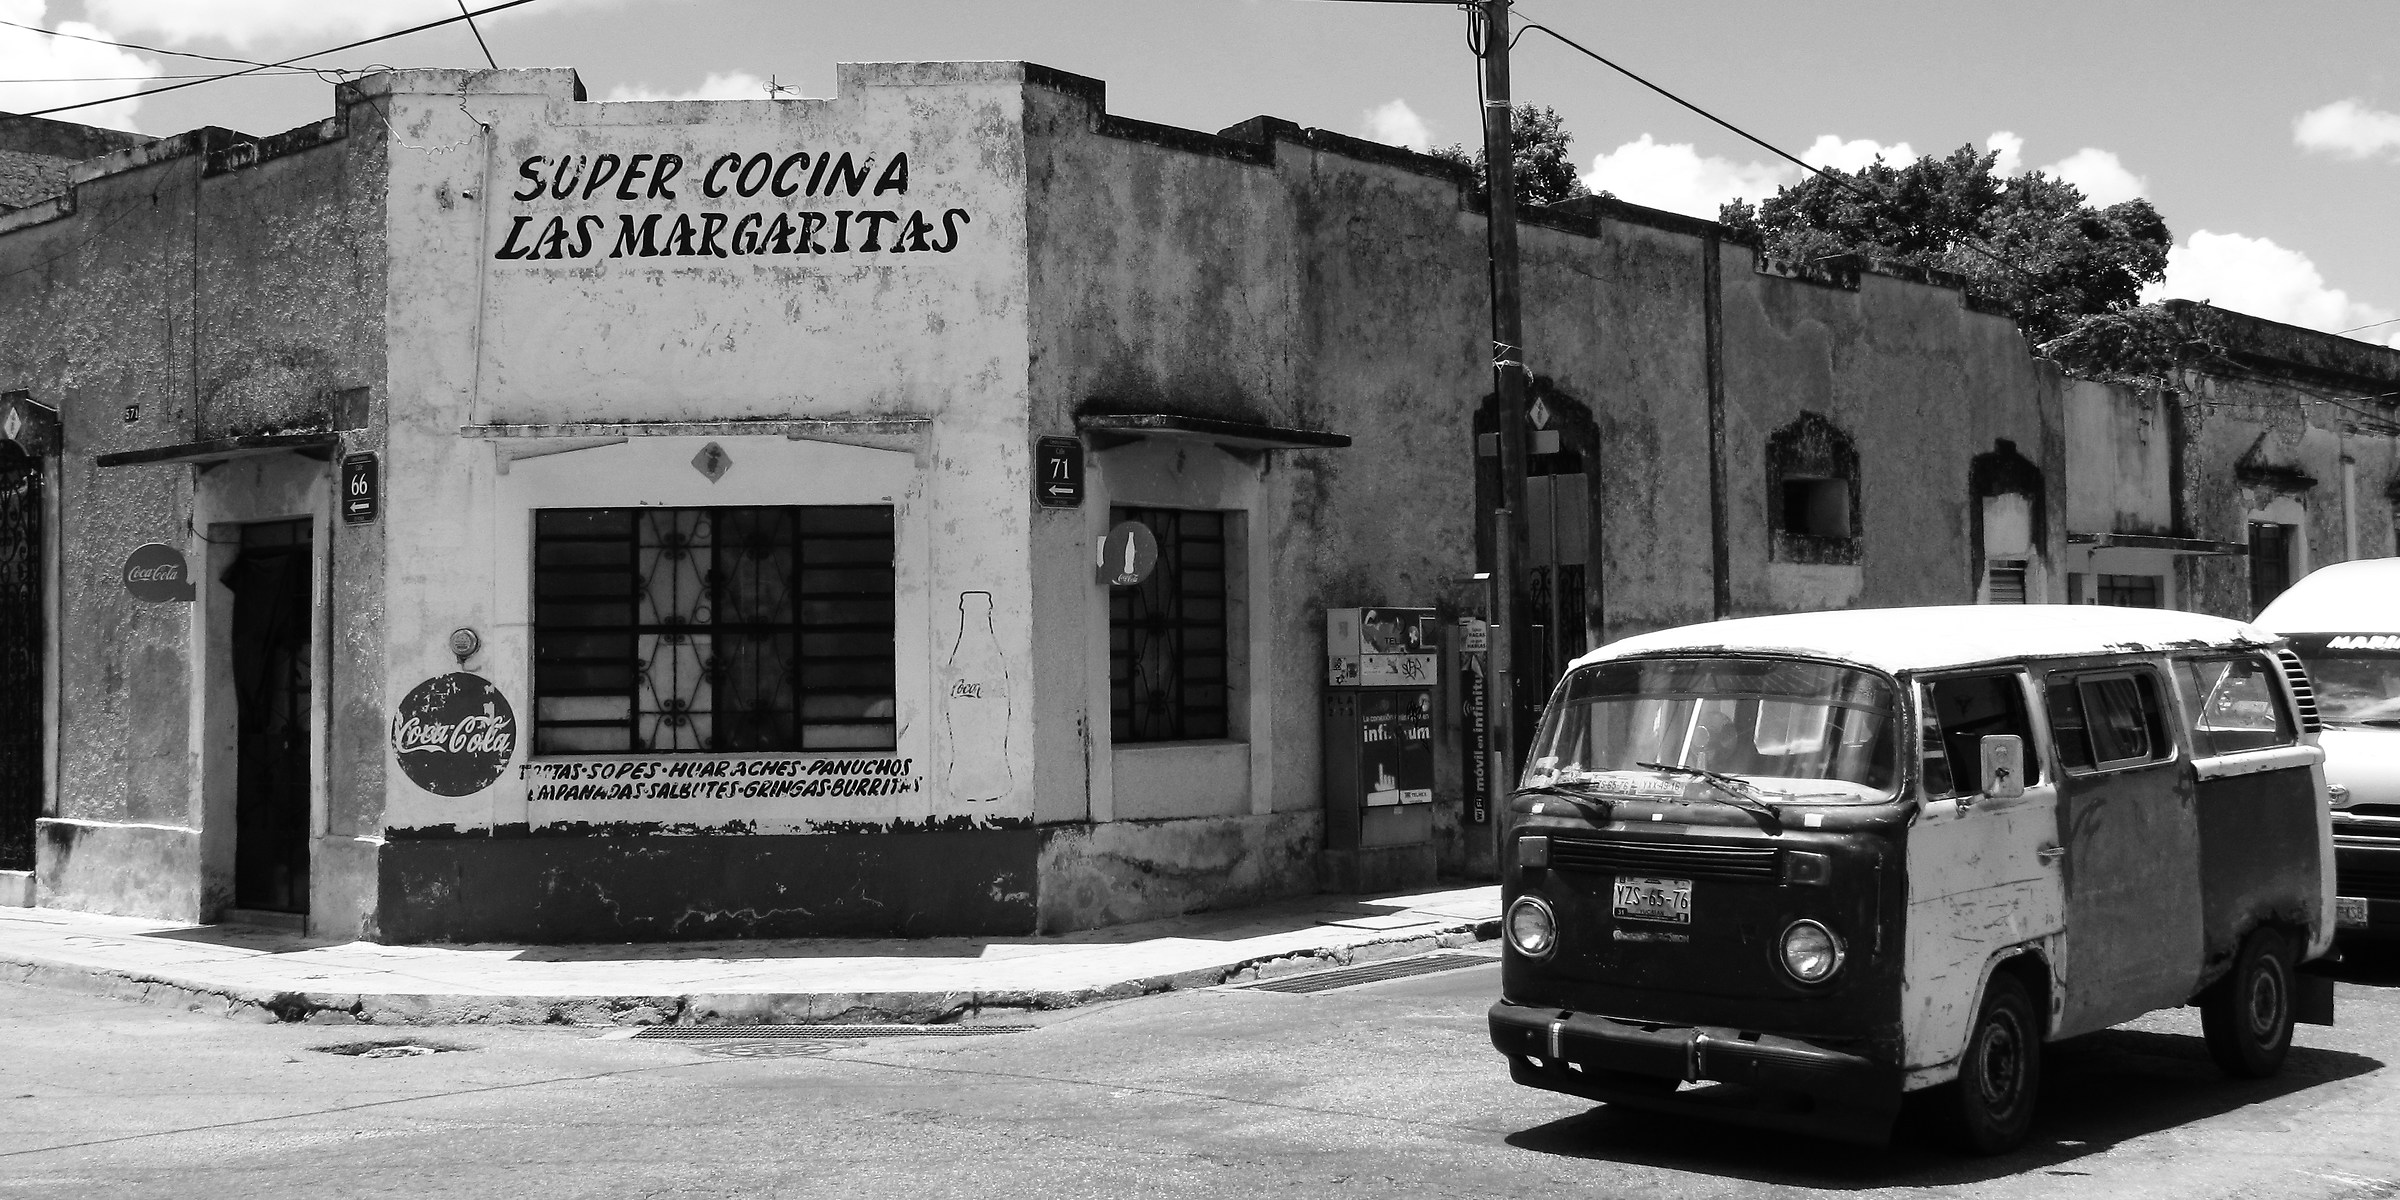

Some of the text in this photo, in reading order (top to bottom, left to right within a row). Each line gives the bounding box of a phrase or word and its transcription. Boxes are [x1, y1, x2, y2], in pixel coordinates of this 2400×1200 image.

[513, 151, 909, 201] SUPER COCINA
[494, 208, 971, 260] LAS MARGARITAS
[1050, 457, 1070, 480] 71
[351, 472, 368, 496] 66
[128, 564, 179, 582] Coca-Cola
[1472, 675, 1484, 733] infinitu
[395, 716, 512, 754] Coca-Cola
[586, 761, 662, 779] SOPES
[806, 758, 913, 777] PANUCHOS
[1473, 750, 1485, 792] móvil
[743, 779, 827, 799] GRINGAS
[1617, 885, 1688, 910] YZS-65-76
